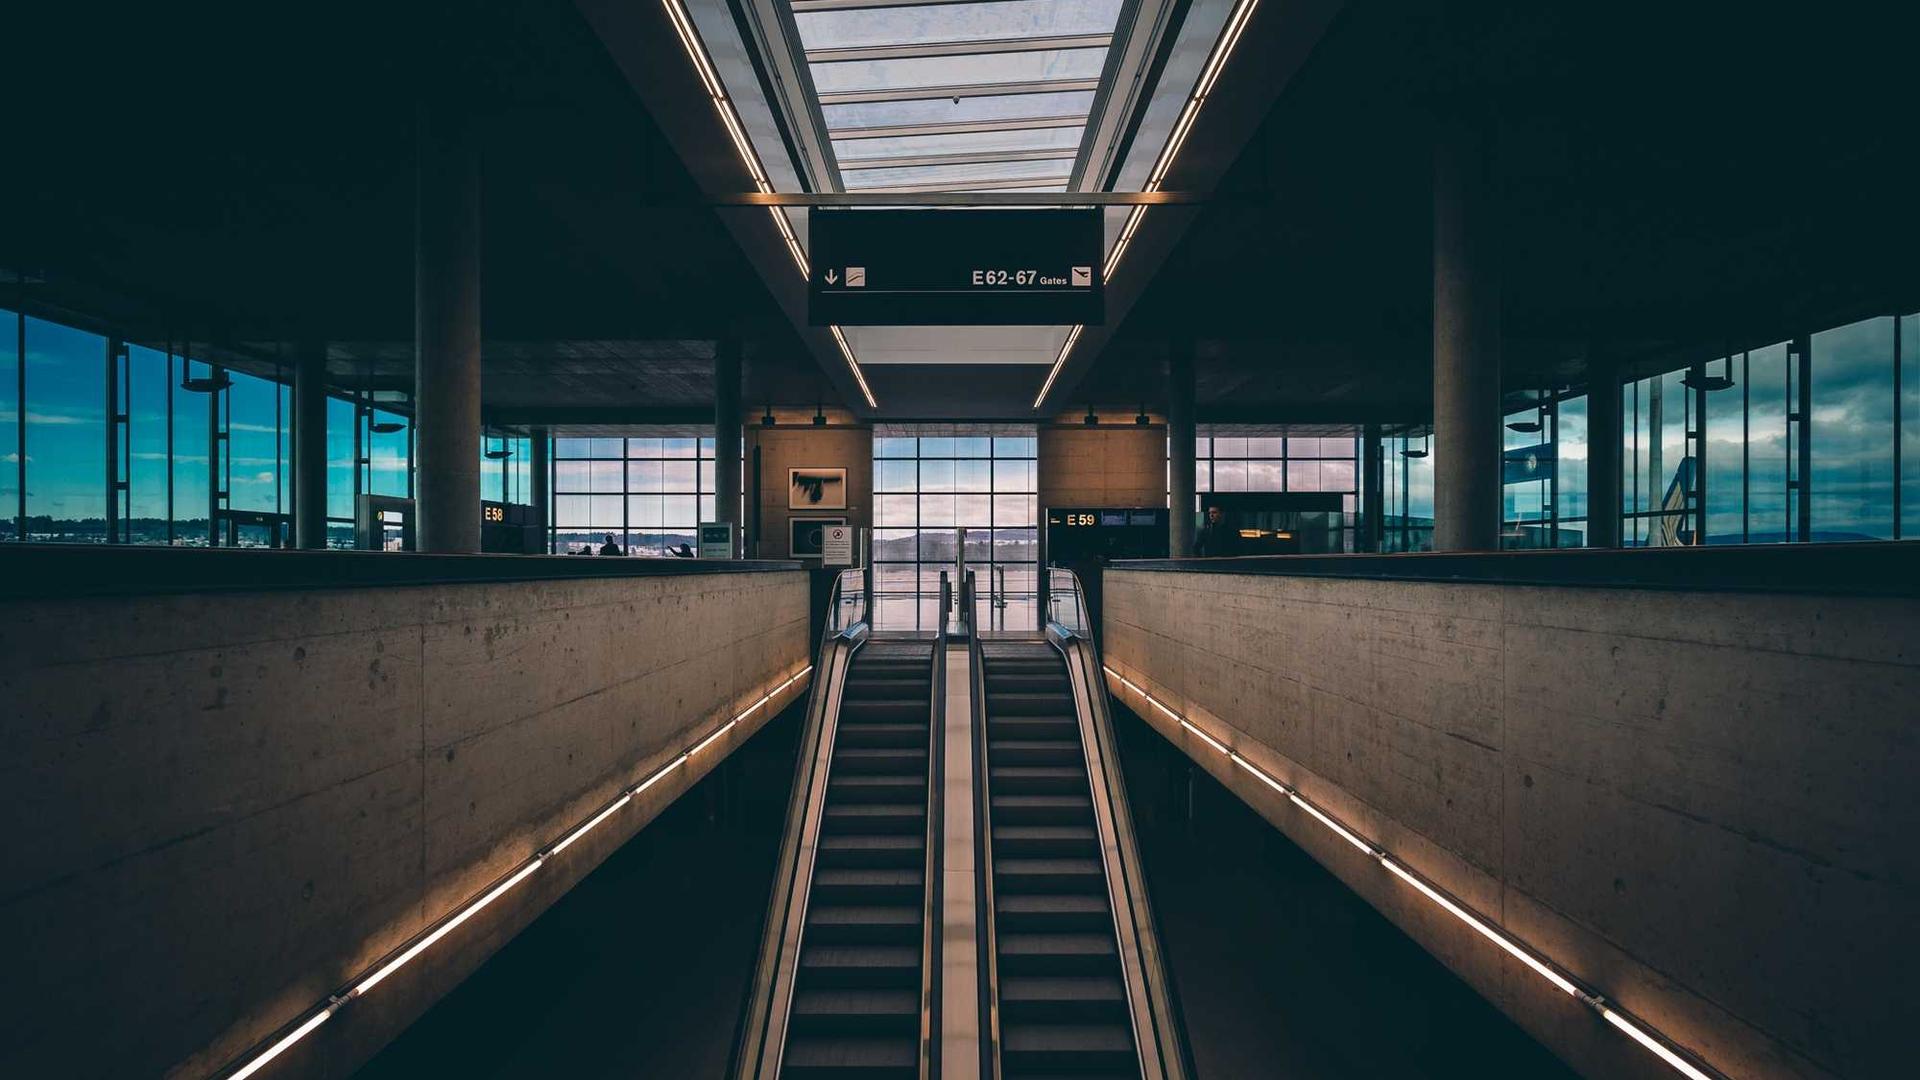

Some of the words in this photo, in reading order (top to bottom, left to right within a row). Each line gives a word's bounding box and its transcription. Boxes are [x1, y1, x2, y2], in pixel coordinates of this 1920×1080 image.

[1040, 276, 1068, 285] Gates
[1066, 514, 1076, 526] E
[1079, 514, 1095, 526] 59
